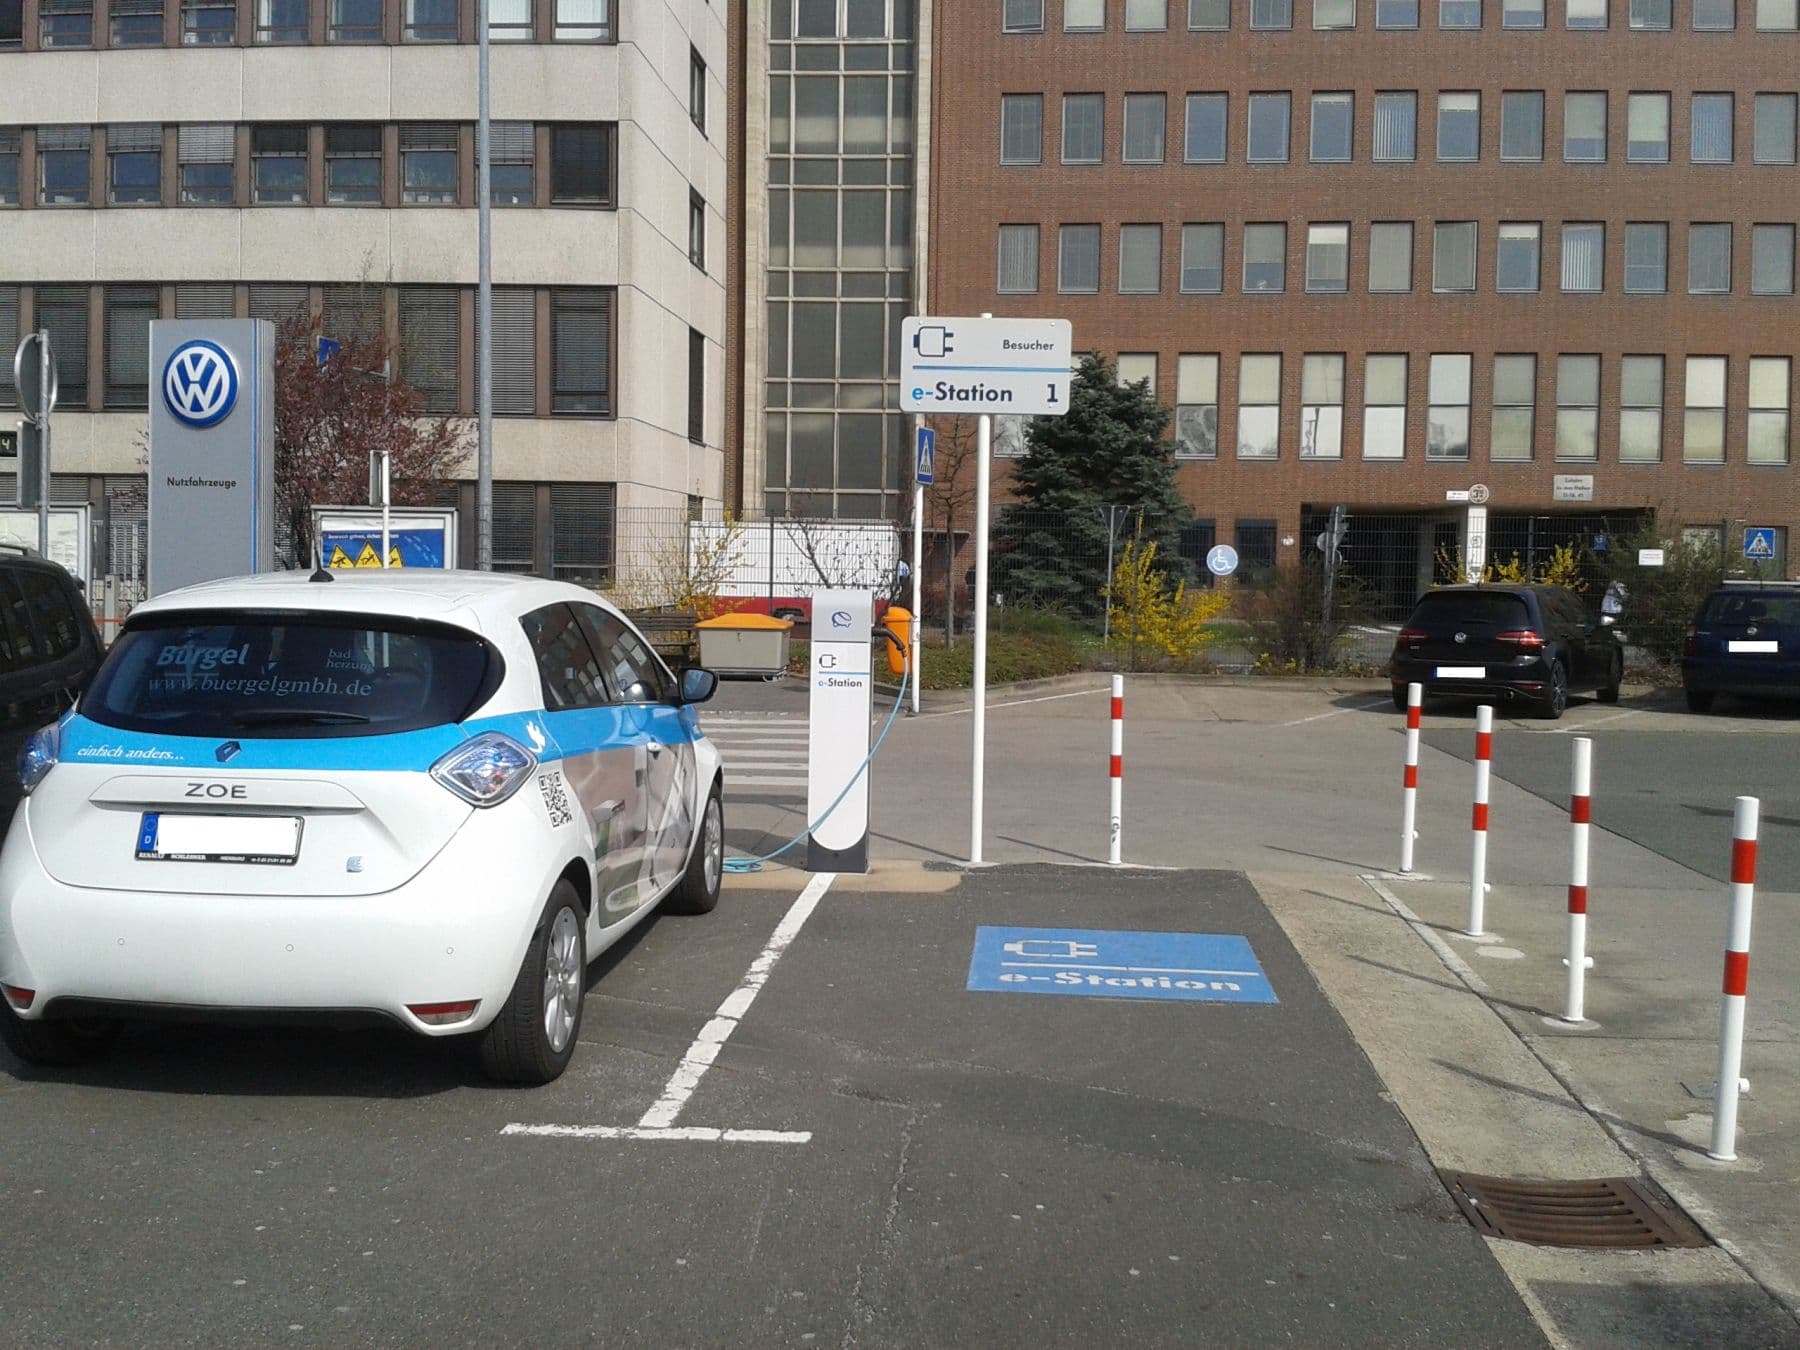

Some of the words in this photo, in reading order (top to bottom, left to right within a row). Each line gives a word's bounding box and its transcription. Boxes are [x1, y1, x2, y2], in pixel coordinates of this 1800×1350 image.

[1002, 339, 1055, 351] Besucher
[911, 381, 1013, 402] e-Station
[1046, 383, 1059, 403] 1
[166, 476, 237, 489] Nutzfahrzeuge
[329, 648, 351, 659] bad
[149, 675, 373, 697] www.buergelgmbh.de
[818, 677, 863, 688] e-Station
[77, 744, 122, 758] einfach
[125, 746, 185, 761] anders...
[185, 783, 248, 799] ZOE
[144, 835, 152, 844] D
[999, 971, 1242, 993] e-Station
